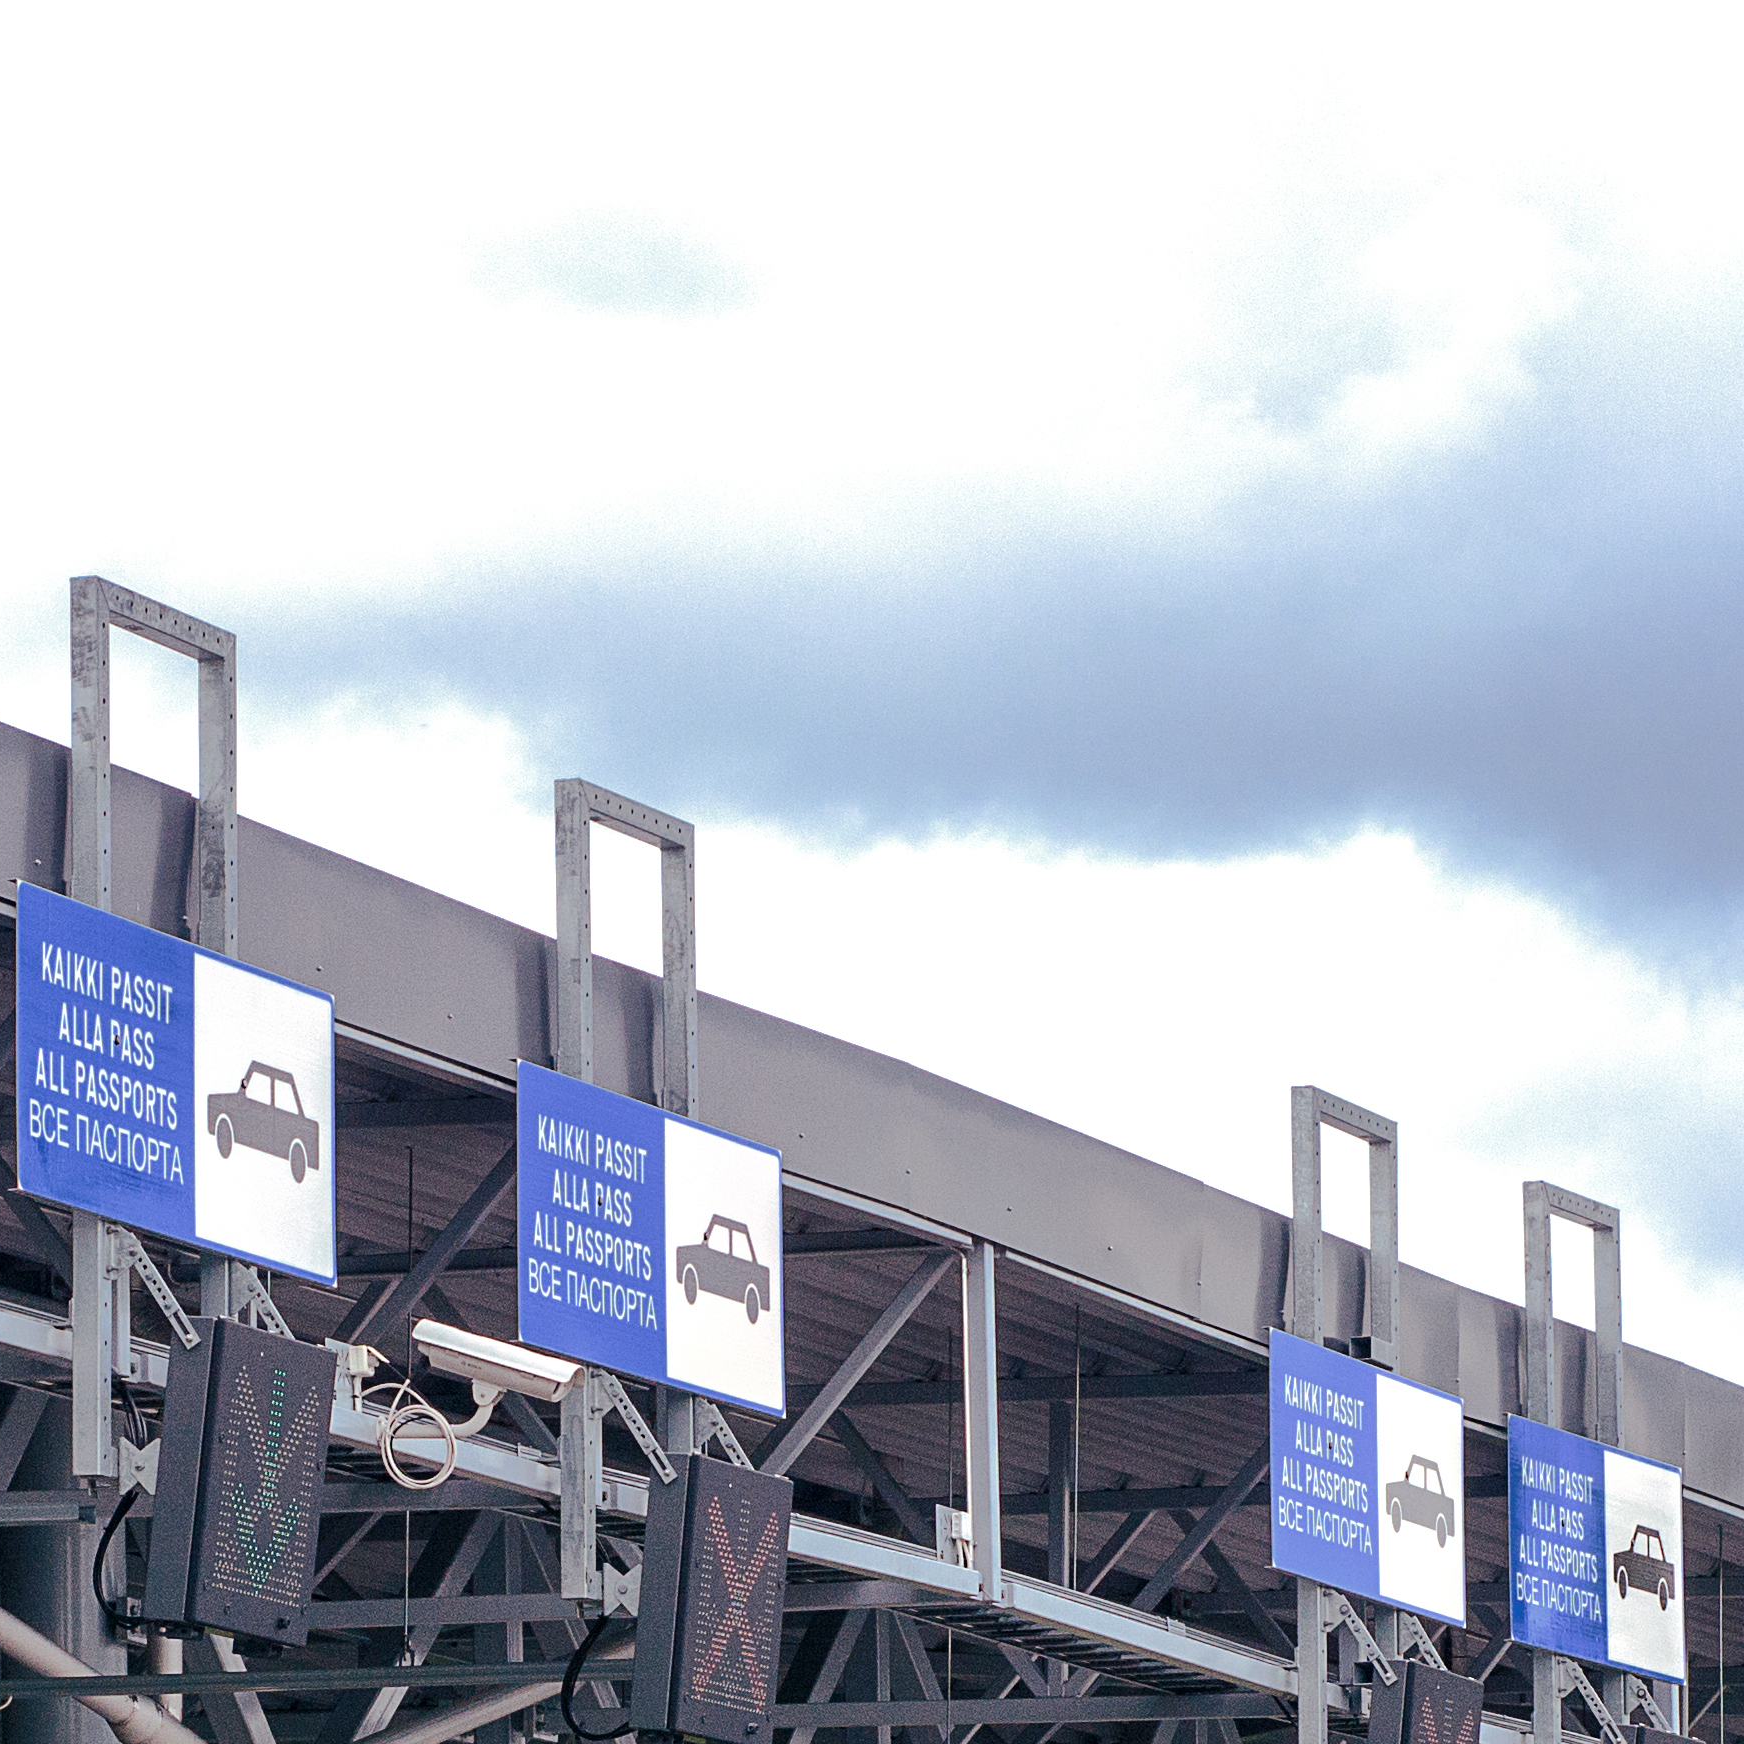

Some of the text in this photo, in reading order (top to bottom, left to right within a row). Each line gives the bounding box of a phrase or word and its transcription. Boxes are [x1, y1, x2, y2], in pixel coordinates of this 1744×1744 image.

[42, 942, 172, 1024] KAIKKI PASSIT
[60, 1003, 154, 1070] ALLA PASS
[36, 1048, 177, 1130] ALL PASSPORTS
[30, 1099, 183, 1185] ВСЕ ПАСПОРТА
[538, 1114, 646, 1184] KAIKKI PASSIT
[553, 1169, 632, 1227] ALLA PASS
[534, 1211, 651, 1281] ALL PASSPORTS
[529, 1258, 657, 1330] ВСЕ ПАСПОРТА
[1285, 1374, 1364, 1430] KAIKKI PASSIT
[1296, 1420, 1353, 1467] ALLA PASS
[1282, 1456, 1368, 1513] ALL PASSPORTS
[1522, 1456, 1593, 1505] KAIKKI PASSIT
[1279, 1496, 1372, 1554] ВСЕ ПАСПОРТА
[1532, 1499, 1584, 1540] ALLA PASS
[1520, 1534, 1597, 1583] ALL PASSPORTS
[1517, 1573, 1602, 1622] ВСЕ ПАСПОРТА
